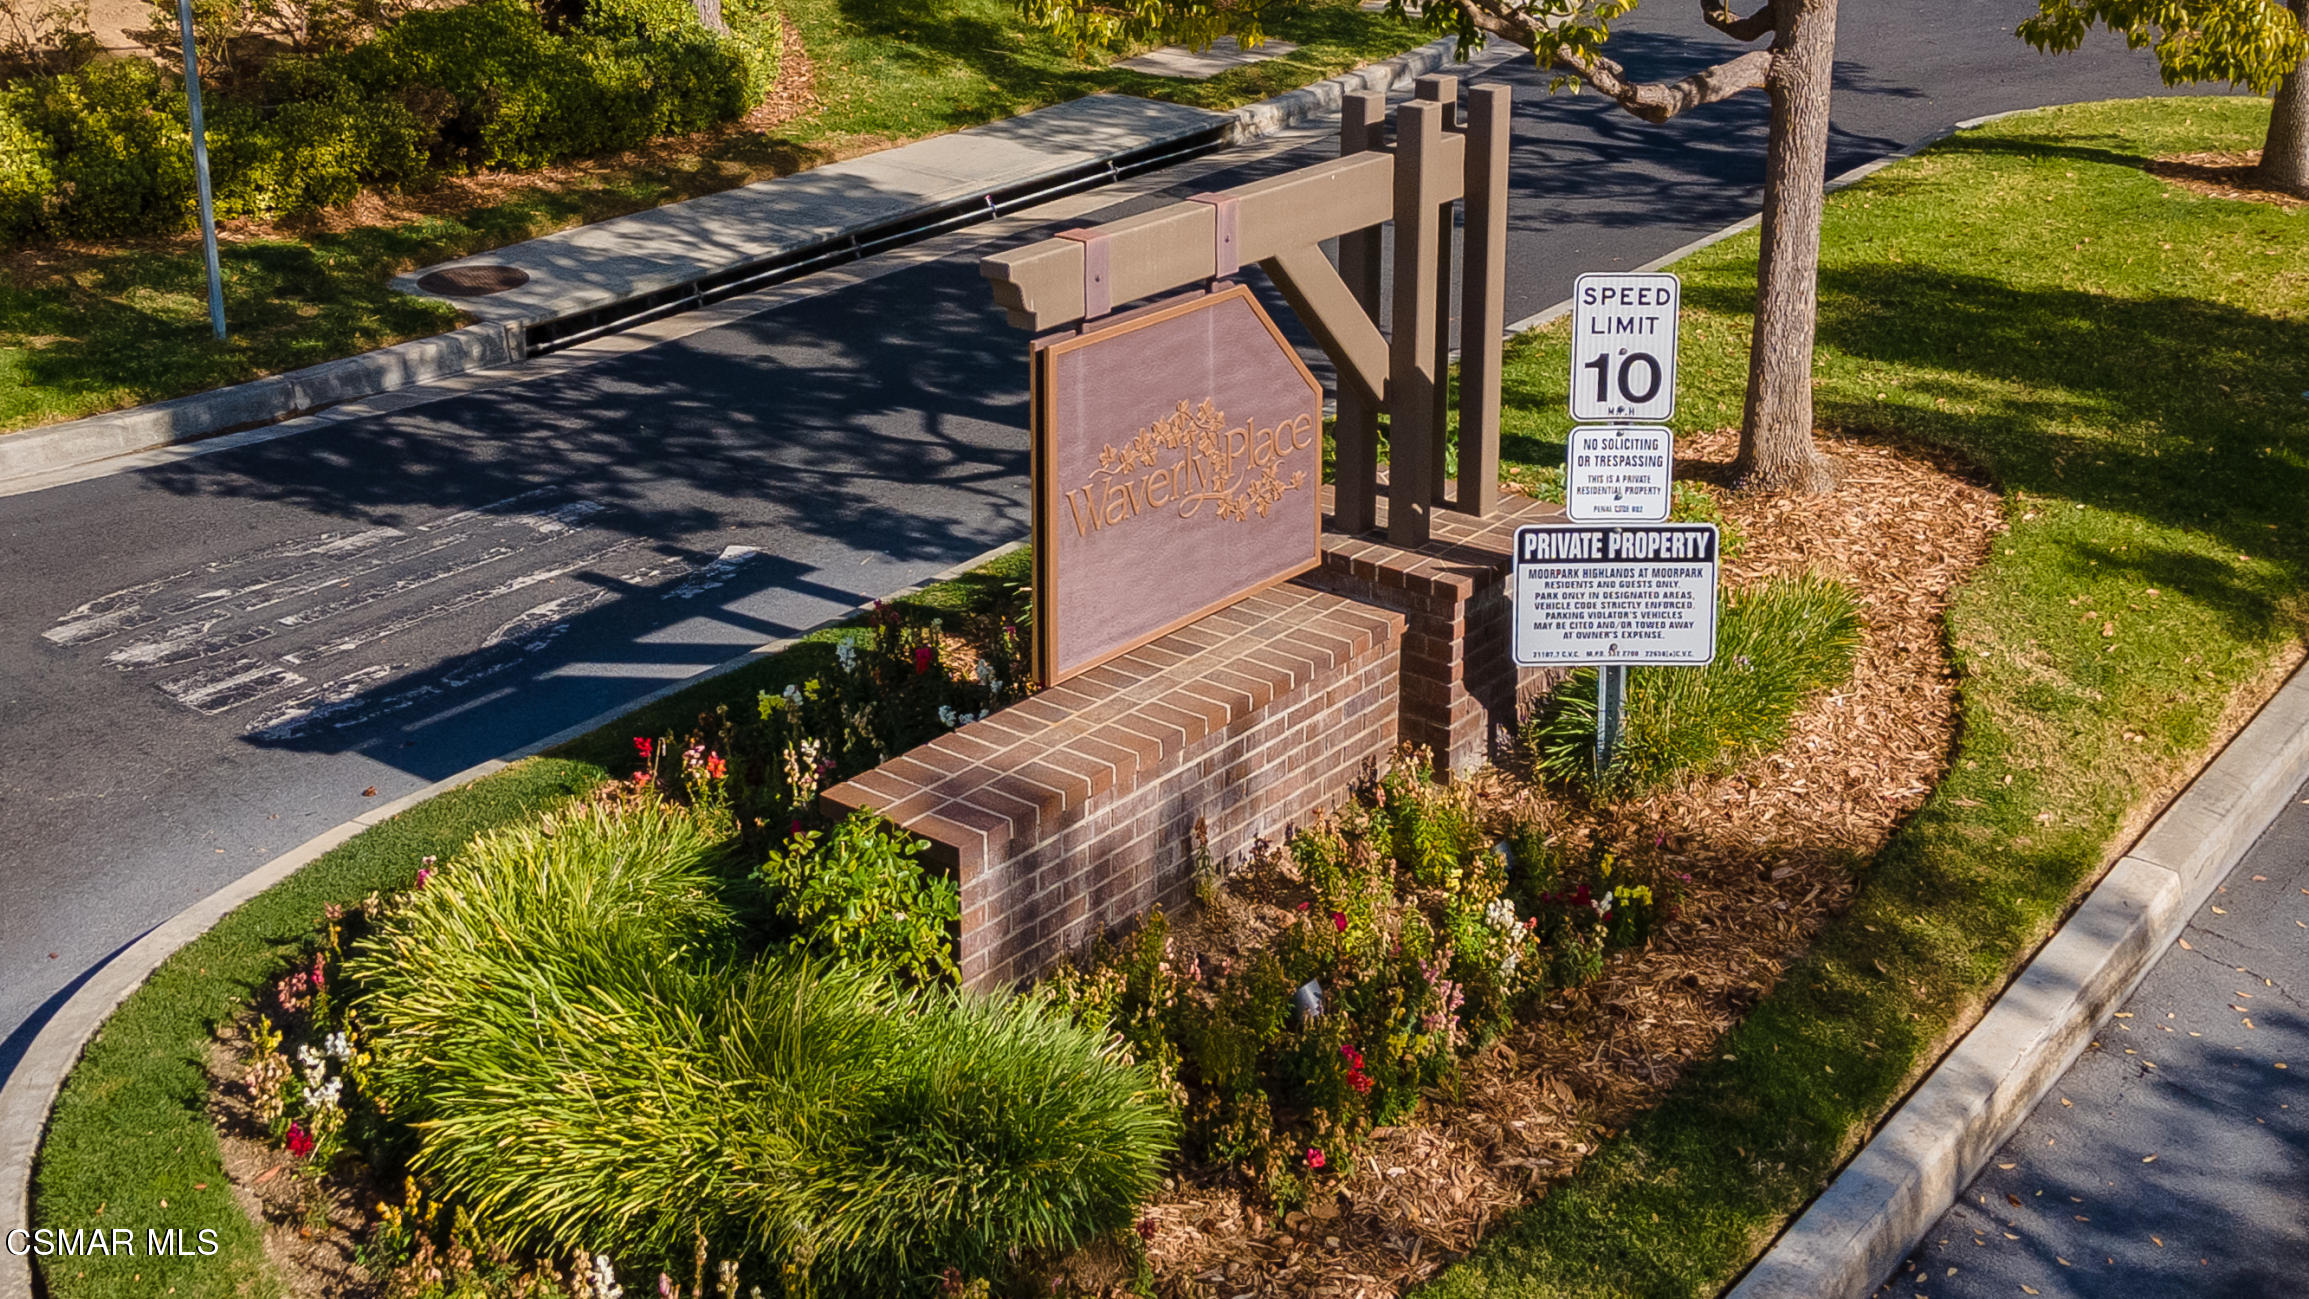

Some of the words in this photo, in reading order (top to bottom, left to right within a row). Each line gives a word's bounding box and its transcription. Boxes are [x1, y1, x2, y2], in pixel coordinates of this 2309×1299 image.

[1583, 287, 1670, 305] SPEED
[1592, 316, 1659, 334] LIMIT
[1585, 352, 1662, 404] 10
[1608, 406, 1635, 416] M..H
[1584, 438, 1598, 450] NO
[1602, 438, 1658, 450] SOLICITING
[1578, 455, 1590, 467] OR
[1595, 455, 1663, 467] TRESPASSING
[1065, 446, 1222, 537] Waverly
[1225, 413, 1313, 478] Place
[1588, 475, 1603, 483] THIS
[1606, 475, 1613, 483] IS
[1615, 475, 1620, 483] A
[1623, 475, 1651, 483] PRIVATE
[1577, 486, 1621, 494] RESIDENTIAL
[1625, 486, 1661, 494] PROPERTY
[1525, 532, 1603, 559] PRIVATE
[1609, 532, 1710, 558] PROPERTY
[1528, 568, 1579, 579] MOORPARK
[1583, 568, 1635, 578] HIGHLANDS
[1638, 568, 1648, 578] AT
[1652, 568, 1703, 578] MOORPARK
[1545, 581, 1594, 589] RESIDENTS
[1535, 592, 1558, 600] PARK
[1535, 602, 1571, 610] VEHICLE
[1545, 612, 1585, 620] PARKING
[1588, 612, 1638, 620] VIOLATOR'S
[1641, 611, 1683, 619] VEHICLES
[1534, 622, 1552, 630] MAY
[1596, 622, 1632, 630] AND/OR
[1669, 621, 1695, 629] AWAY
